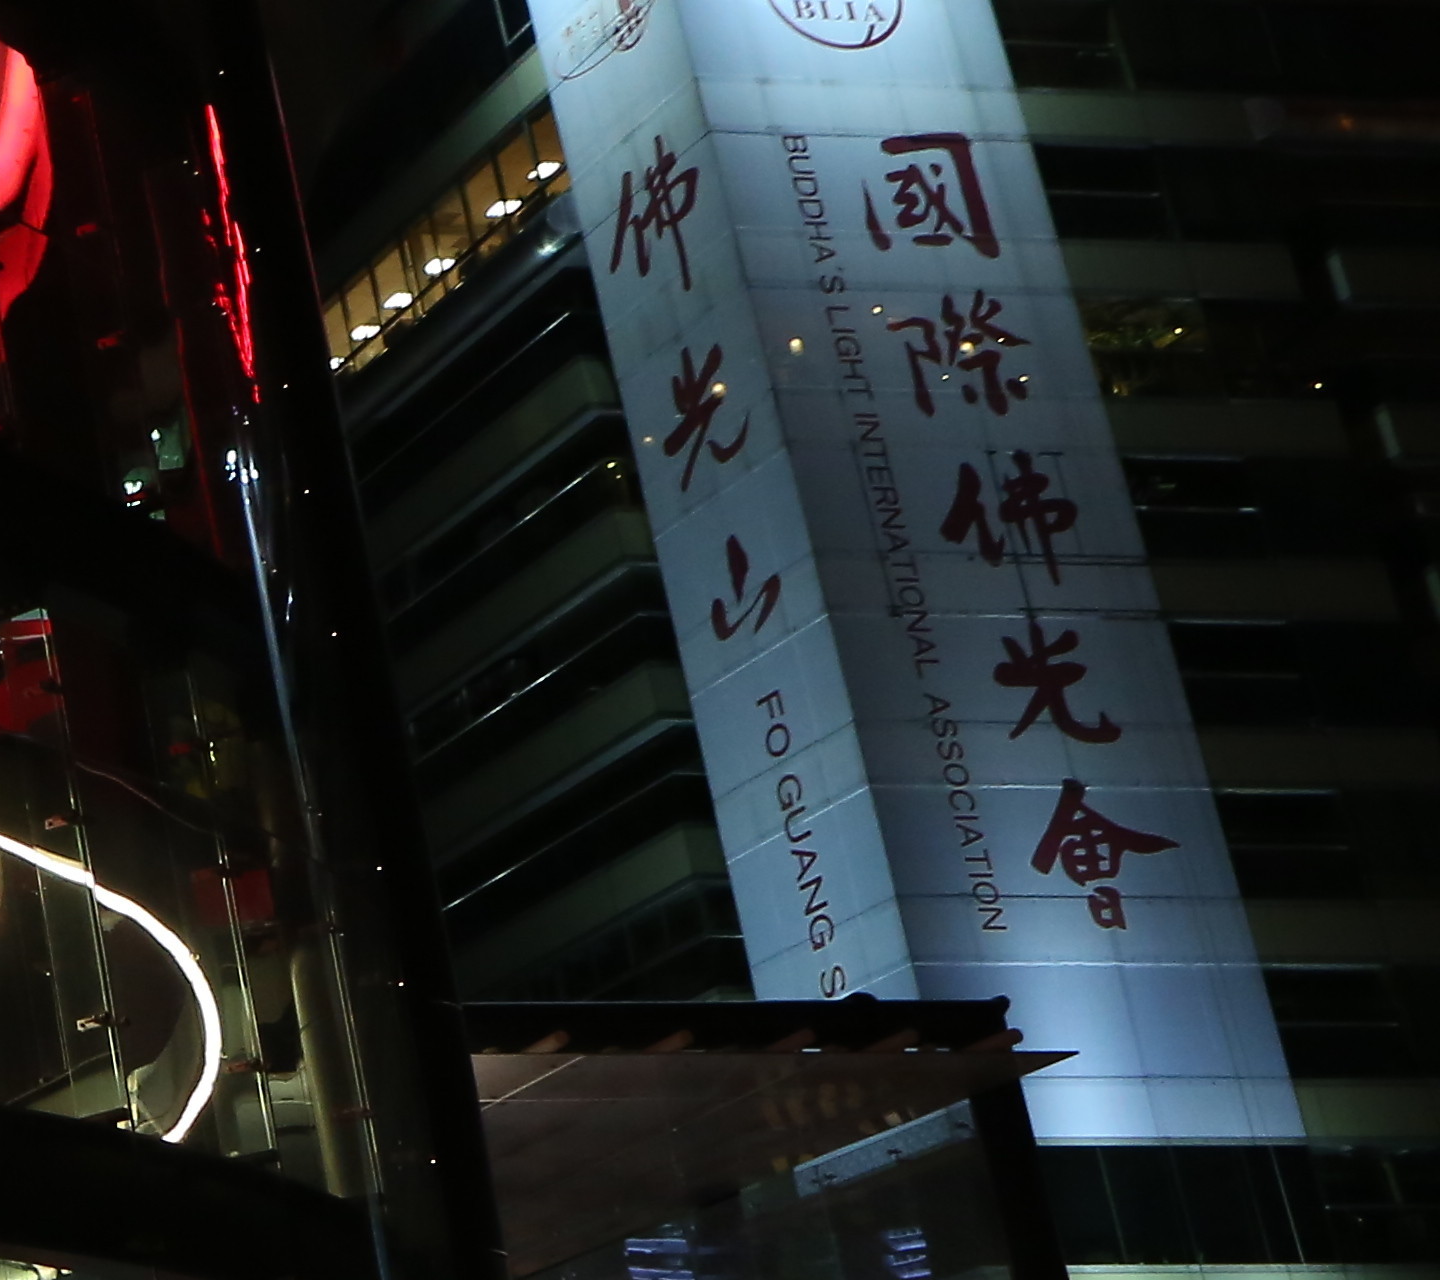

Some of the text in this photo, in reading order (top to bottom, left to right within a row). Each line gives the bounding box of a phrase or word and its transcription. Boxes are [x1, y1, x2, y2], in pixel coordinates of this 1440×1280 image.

[610, 134, 783, 642] 佛光山
[782, 133, 1009, 934] BUDDHA'S LIGHT INTERNATIONAL ASSOCIATION
[862, 133, 1181, 931] 國際佛光會
[755, 688, 793, 760] FO
[774, 773, 836, 954] GUANG
